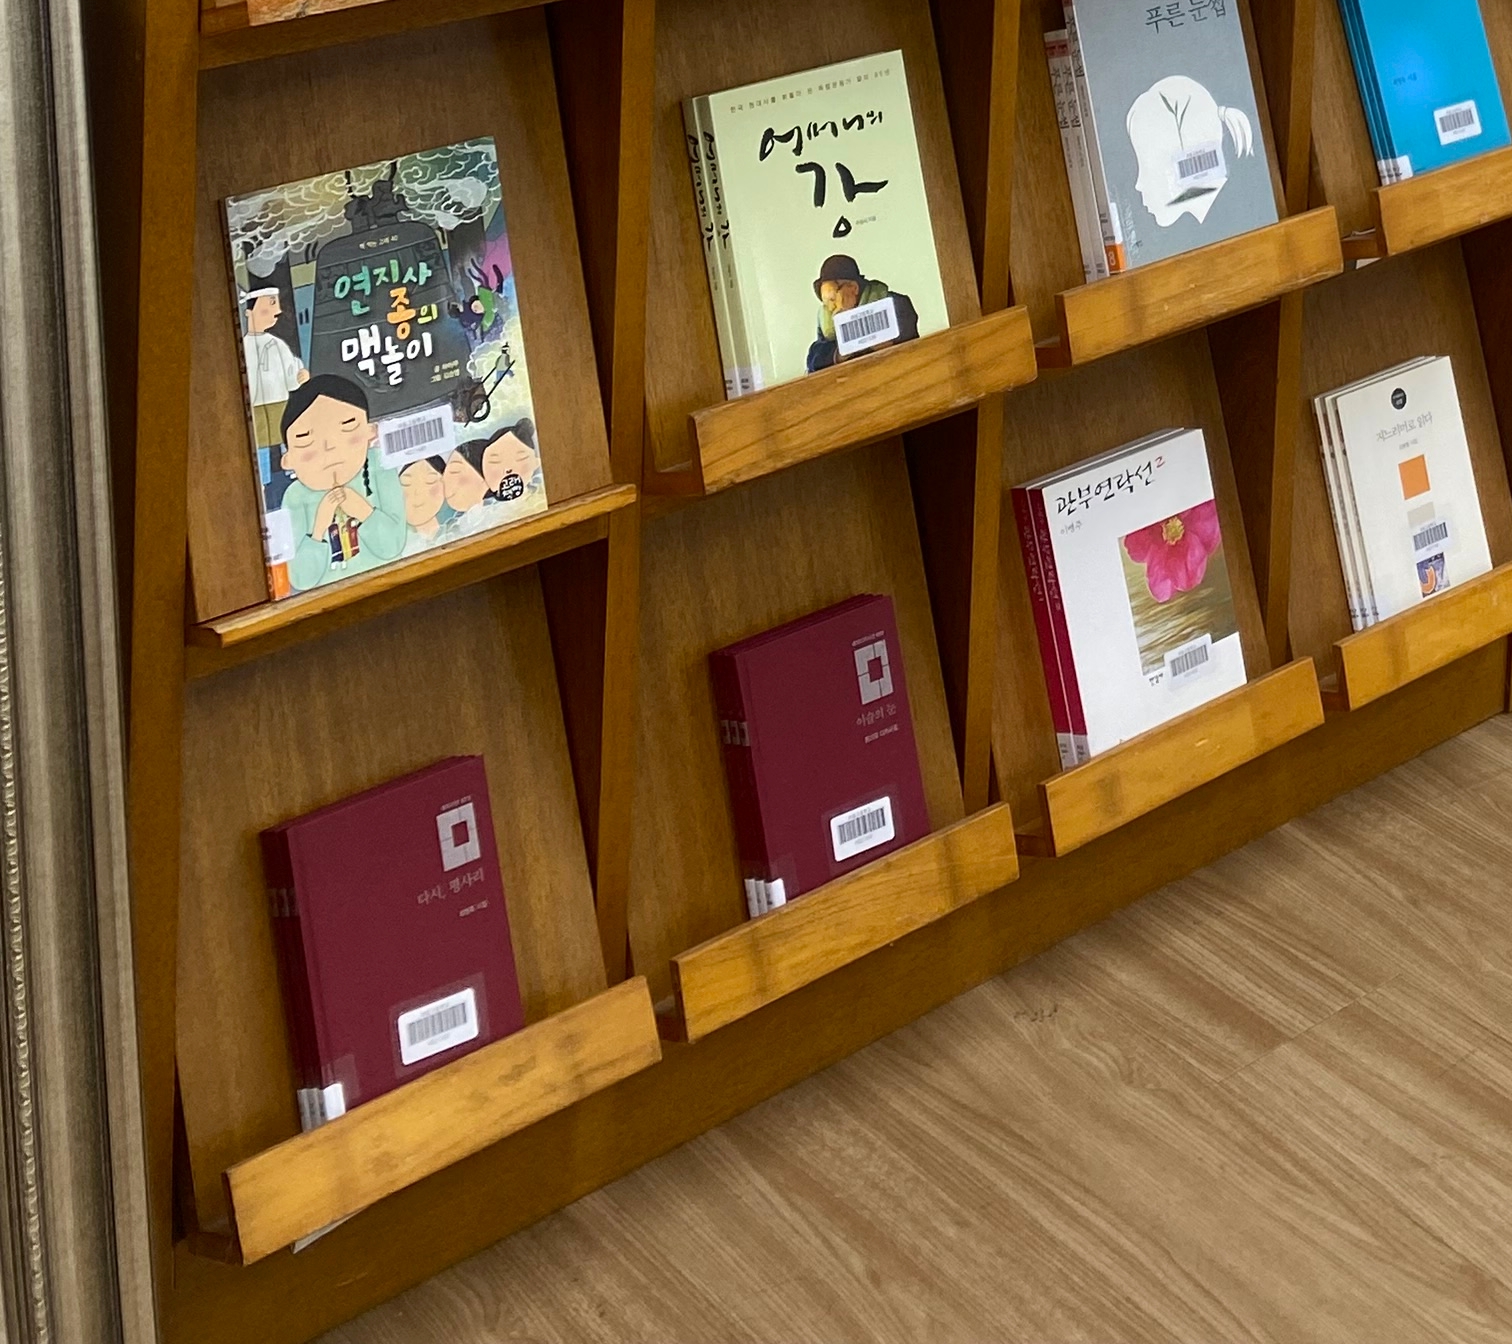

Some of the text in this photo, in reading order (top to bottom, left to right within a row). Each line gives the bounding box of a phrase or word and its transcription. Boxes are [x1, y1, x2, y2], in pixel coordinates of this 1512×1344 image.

[1144, 3, 1185, 34] 푸른
[759, 110, 883, 162] 어머니의
[796, 162, 889, 238] 강
[333, 262, 432, 316] 연지사
[386, 285, 438, 340] 종의
[341, 325, 433, 386] 맥놀이
[1055, 461, 1157, 517] 관부연락선
[448, 867, 486, 894] 평사리
